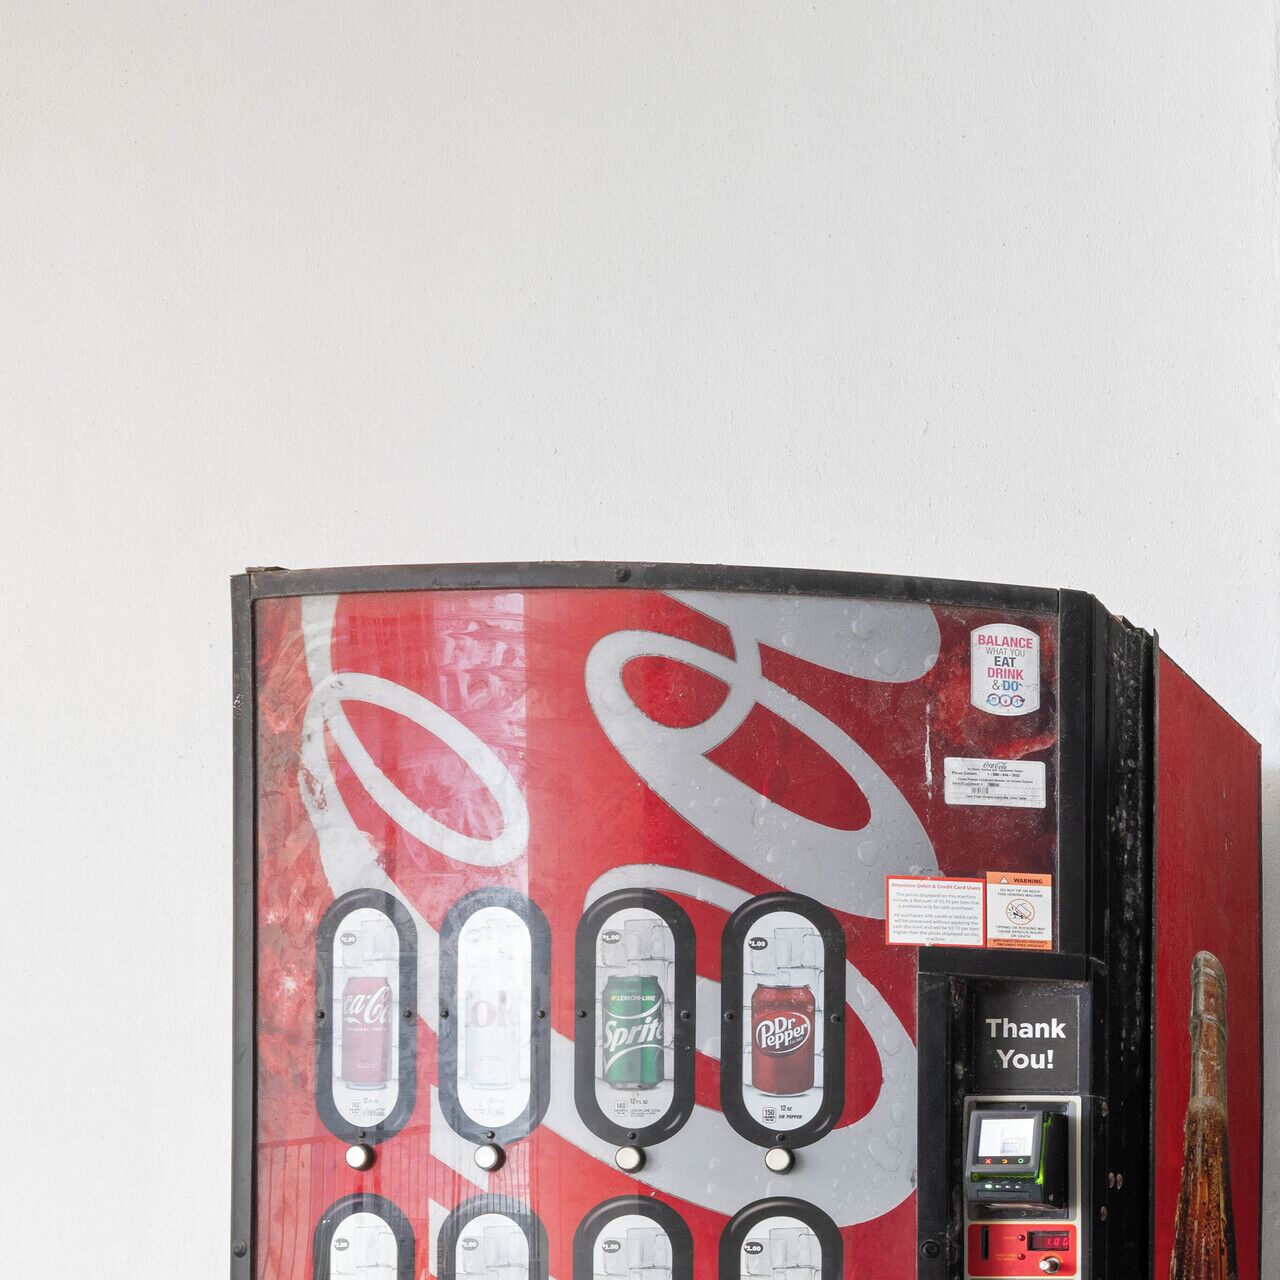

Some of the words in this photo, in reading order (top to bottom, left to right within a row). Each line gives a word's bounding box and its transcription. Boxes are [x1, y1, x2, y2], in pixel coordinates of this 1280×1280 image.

[977, 634, 1033, 649] BALANCE
[985, 646, 1007, 655] WHAT
[1009, 648, 1026, 657] YOU
[994, 656, 1016, 667] EAT
[987, 667, 1024, 680] DRINK
[992, 679, 999, 690] &
[1002, 680, 1019, 691] DO
[602, 934, 620, 942] $1.00
[749, 940, 766, 948] $1.00
[774, 1015, 796, 1031] Dr
[985, 1018, 1066, 1039] Thank
[760, 1020, 808, 1049] Pepper
[997, 1049, 1054, 1069] You!
[744, 1244, 761, 1252] $1.00
